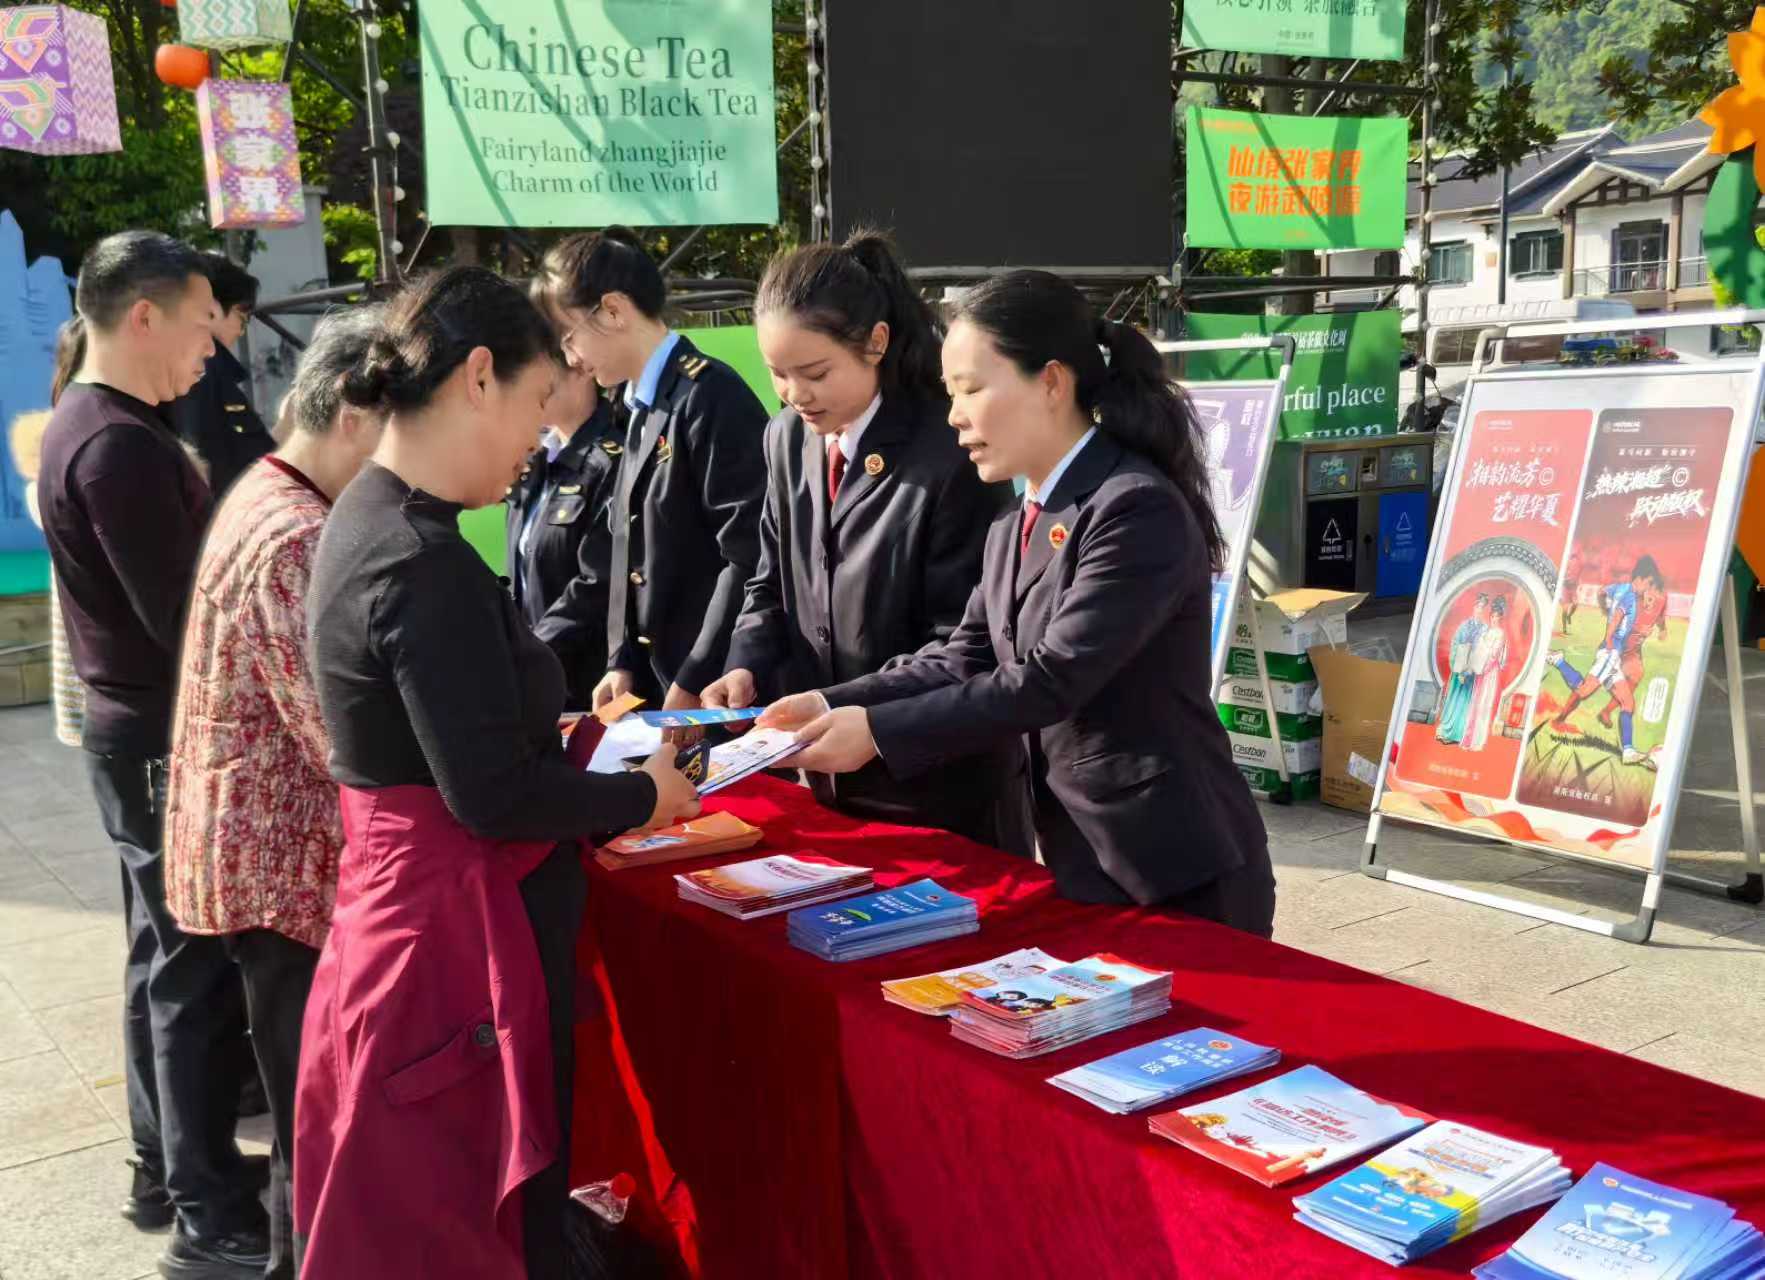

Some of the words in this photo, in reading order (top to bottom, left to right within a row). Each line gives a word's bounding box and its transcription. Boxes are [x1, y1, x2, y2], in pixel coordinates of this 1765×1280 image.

[463, 23, 646, 79] Chinese
[657, 36, 733, 79] Tea
[442, 75, 609, 117] Tianzishan
[620, 87, 702, 117] Black
[708, 88, 757, 116] Tea
[480, 136, 592, 167] Fairyland
[600, 141, 727, 168] zhangjiajie
[493, 170, 573, 193] Charm
[579, 171, 600, 193] of
[608, 171, 644, 193] the
[651, 171, 718, 193] World
[1284, 385, 1321, 412] rful
[1327, 382, 1386, 415] place
